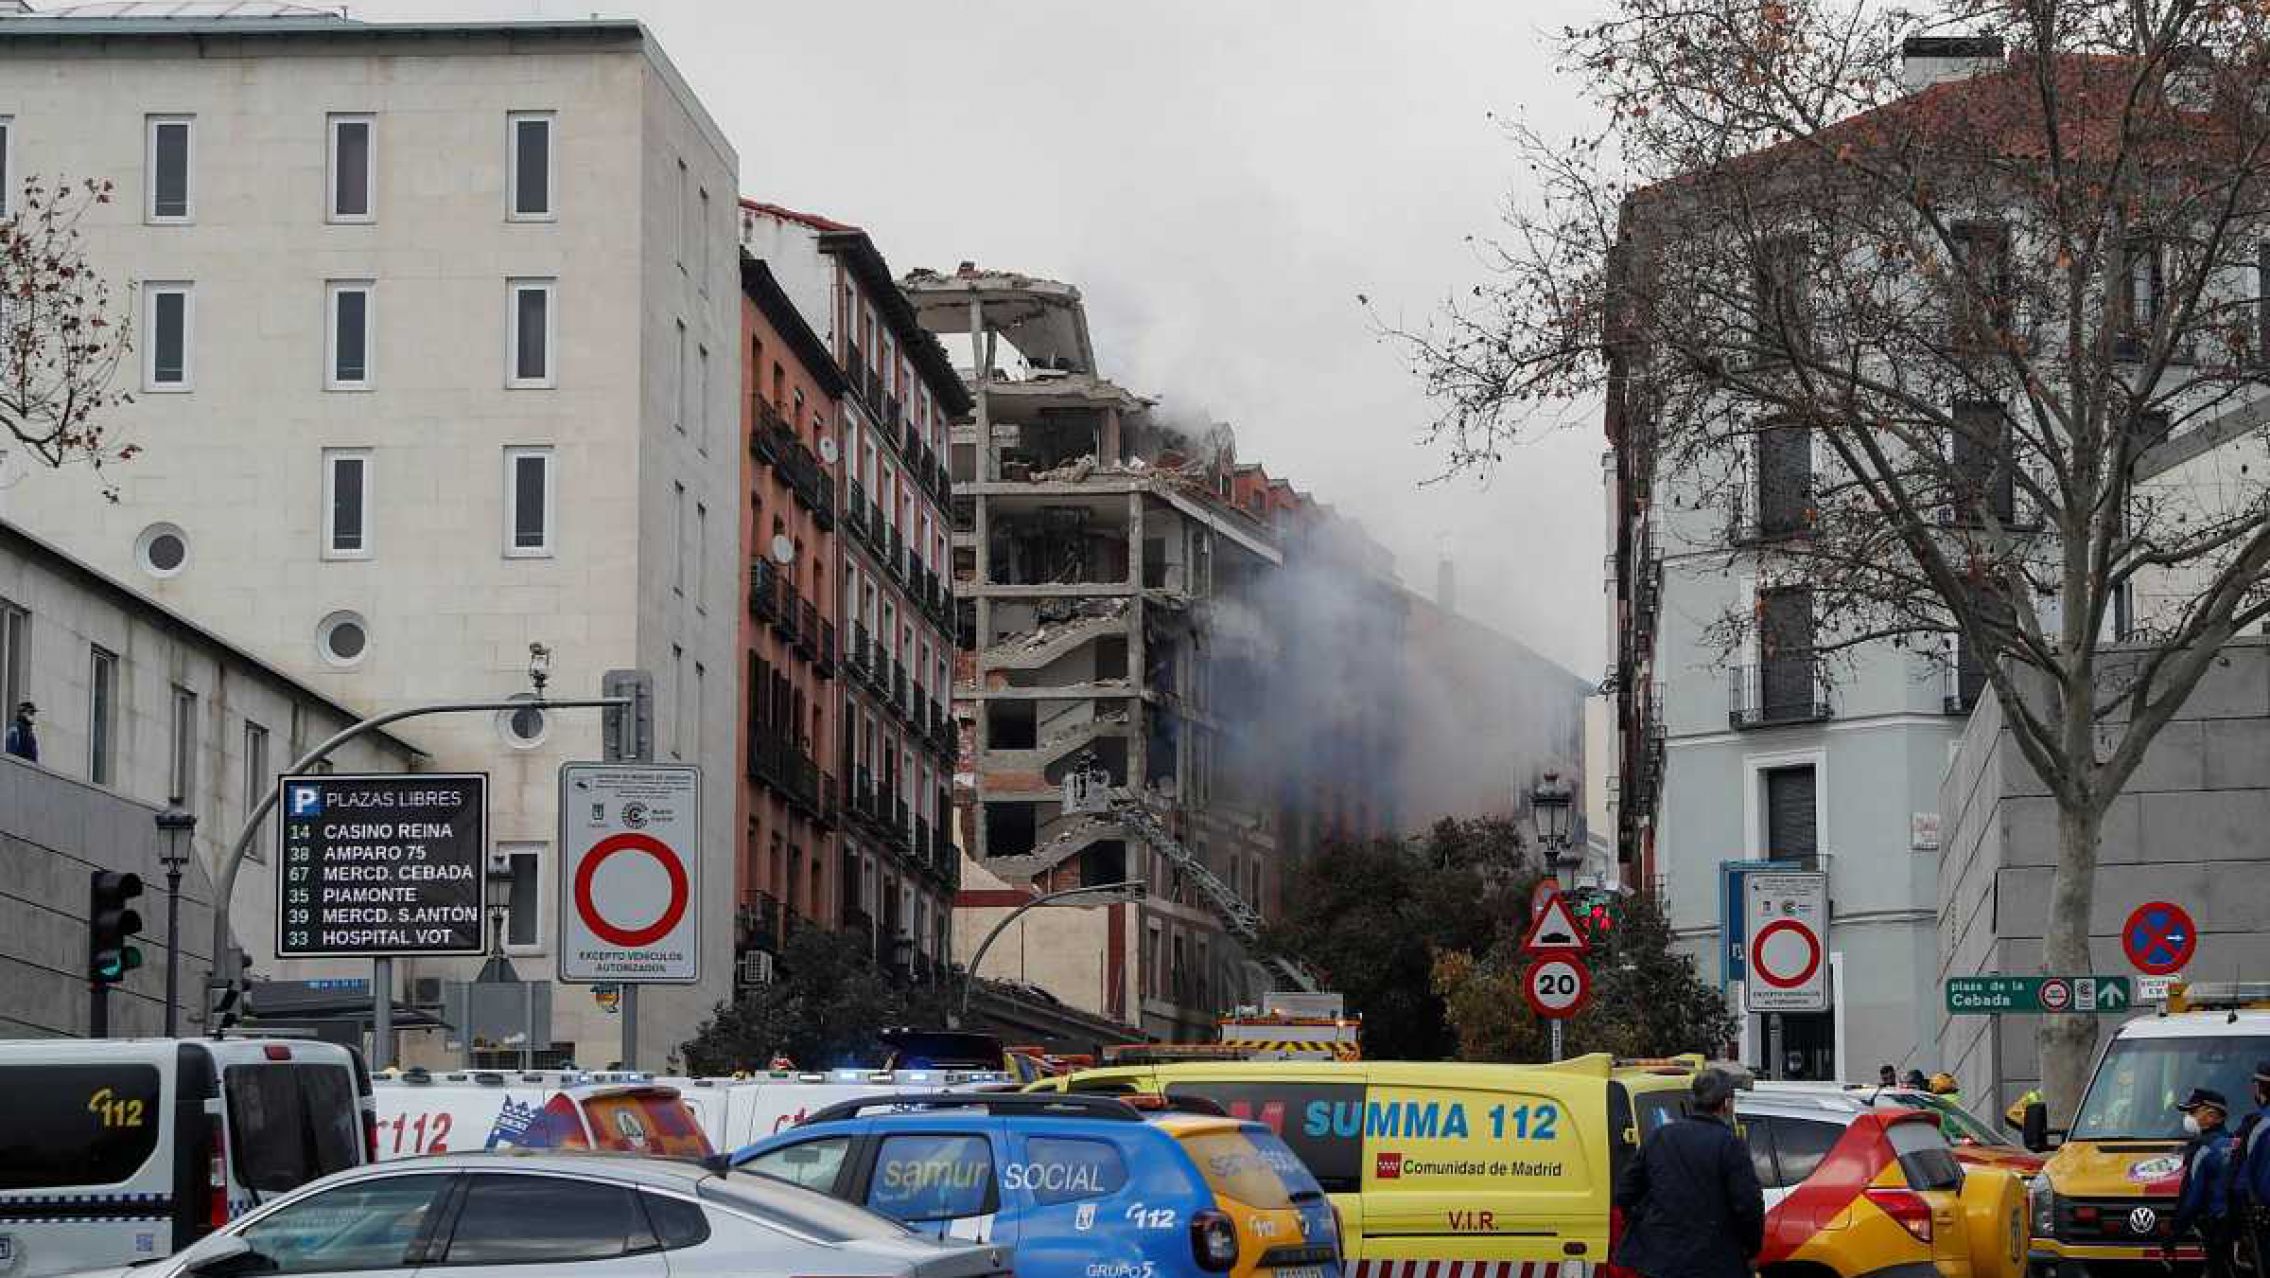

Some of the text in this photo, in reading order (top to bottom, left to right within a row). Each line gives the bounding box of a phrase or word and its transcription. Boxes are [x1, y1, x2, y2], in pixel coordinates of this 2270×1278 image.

[294, 789, 317, 813] P
[326, 791, 462, 808] PLAZAS LIBRES
[289, 823, 453, 839] 14 CASINO REINA
[289, 846, 427, 861] 38 AMPARO 75
[289, 865, 474, 882] 67 MERCD. CEBADA
[289, 887, 417, 903] 35 PIAMONTE
[289, 904, 478, 924] 39 MERCD. S.ANTÓN
[288, 929, 453, 946] 33 HOSPITAL VOT
[596, 963, 667, 973] AUTORIZADOS
[1539, 975, 1575, 995] 20
[1951, 980, 2025, 992] plaza de la
[1951, 993, 2012, 1006] Cebada
[101, 1099, 143, 1126] 112
[1303, 1101, 1468, 1139] SUMMA
[1489, 1103, 1558, 1140] 112
[393, 1112, 452, 1154] 112
[884, 1160, 1105, 1192] samur SOCIAL
[1403, 1160, 1562, 1177] Comunidad de Madrid
[1135, 1208, 1176, 1229] 112
[1449, 1211, 1500, 1231] V.I.R.
